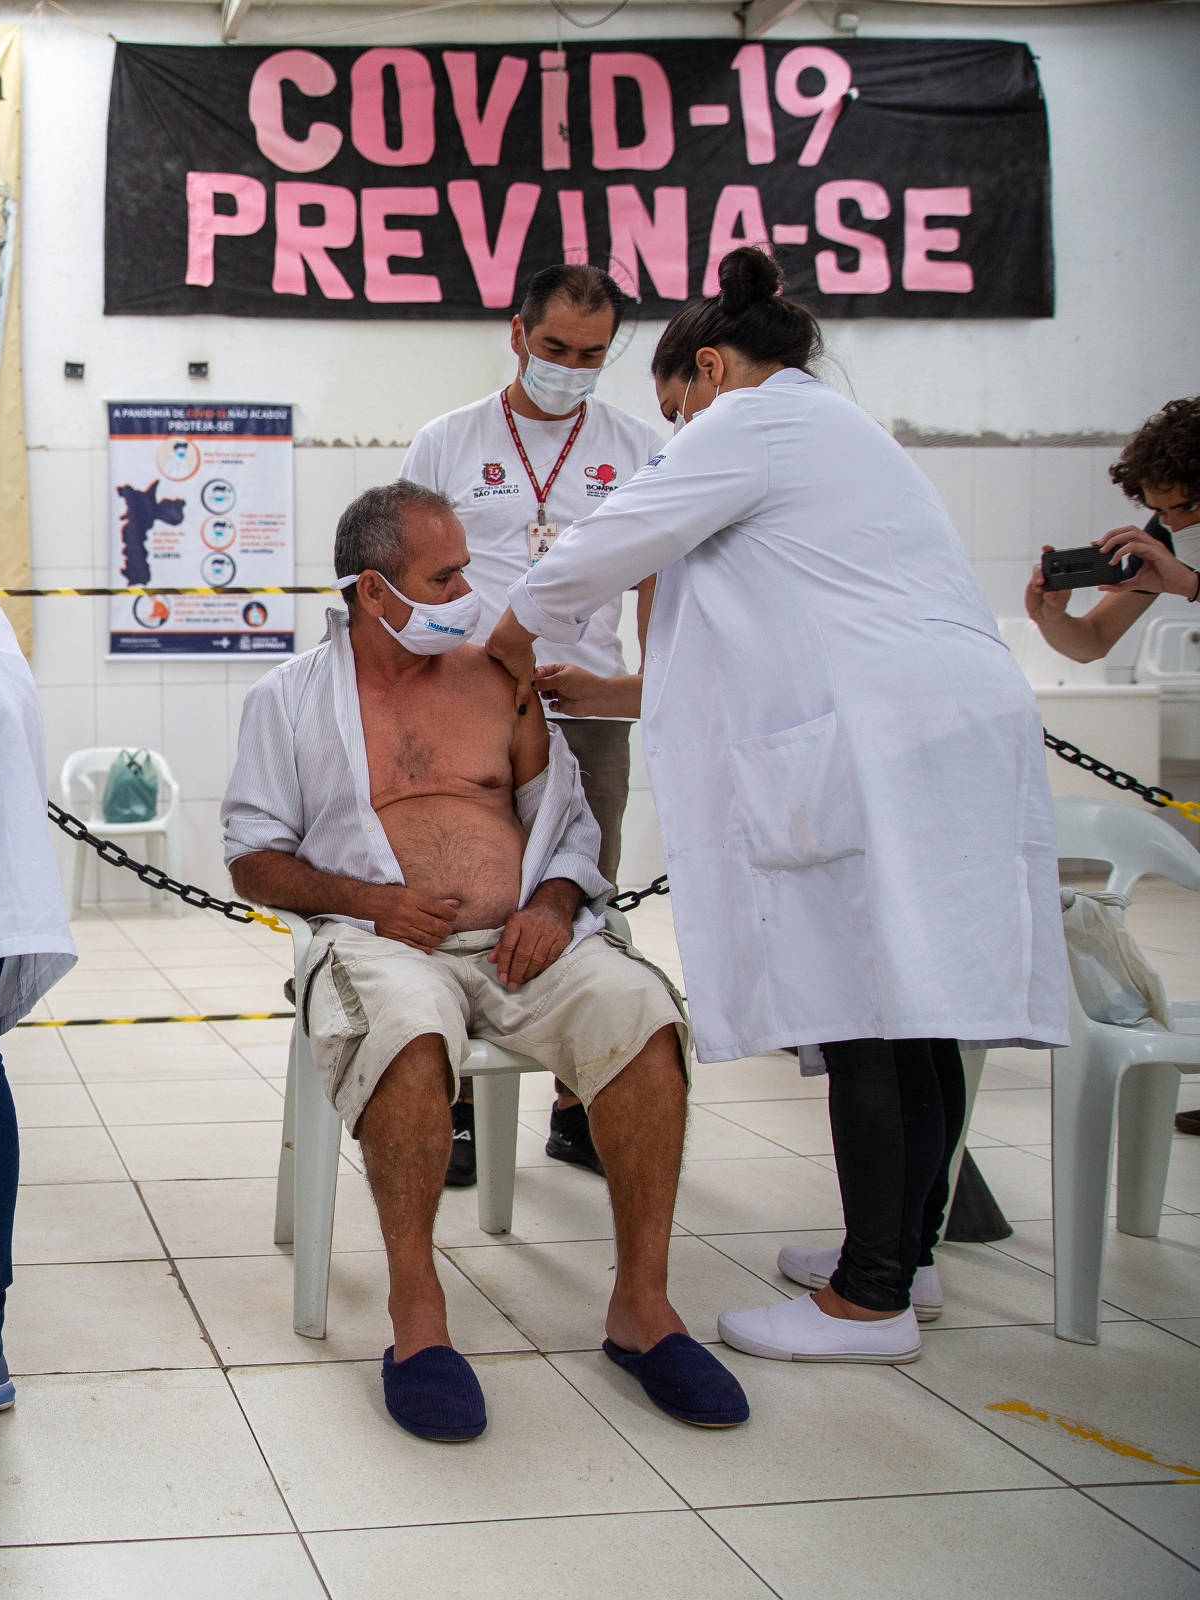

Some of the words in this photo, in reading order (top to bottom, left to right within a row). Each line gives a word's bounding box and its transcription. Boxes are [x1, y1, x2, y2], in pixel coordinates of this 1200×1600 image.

[249, 44, 852, 173] COVID-19
[185, 171, 974, 308] PREVINA-SE
[473, 489, 490, 498] SÃO
